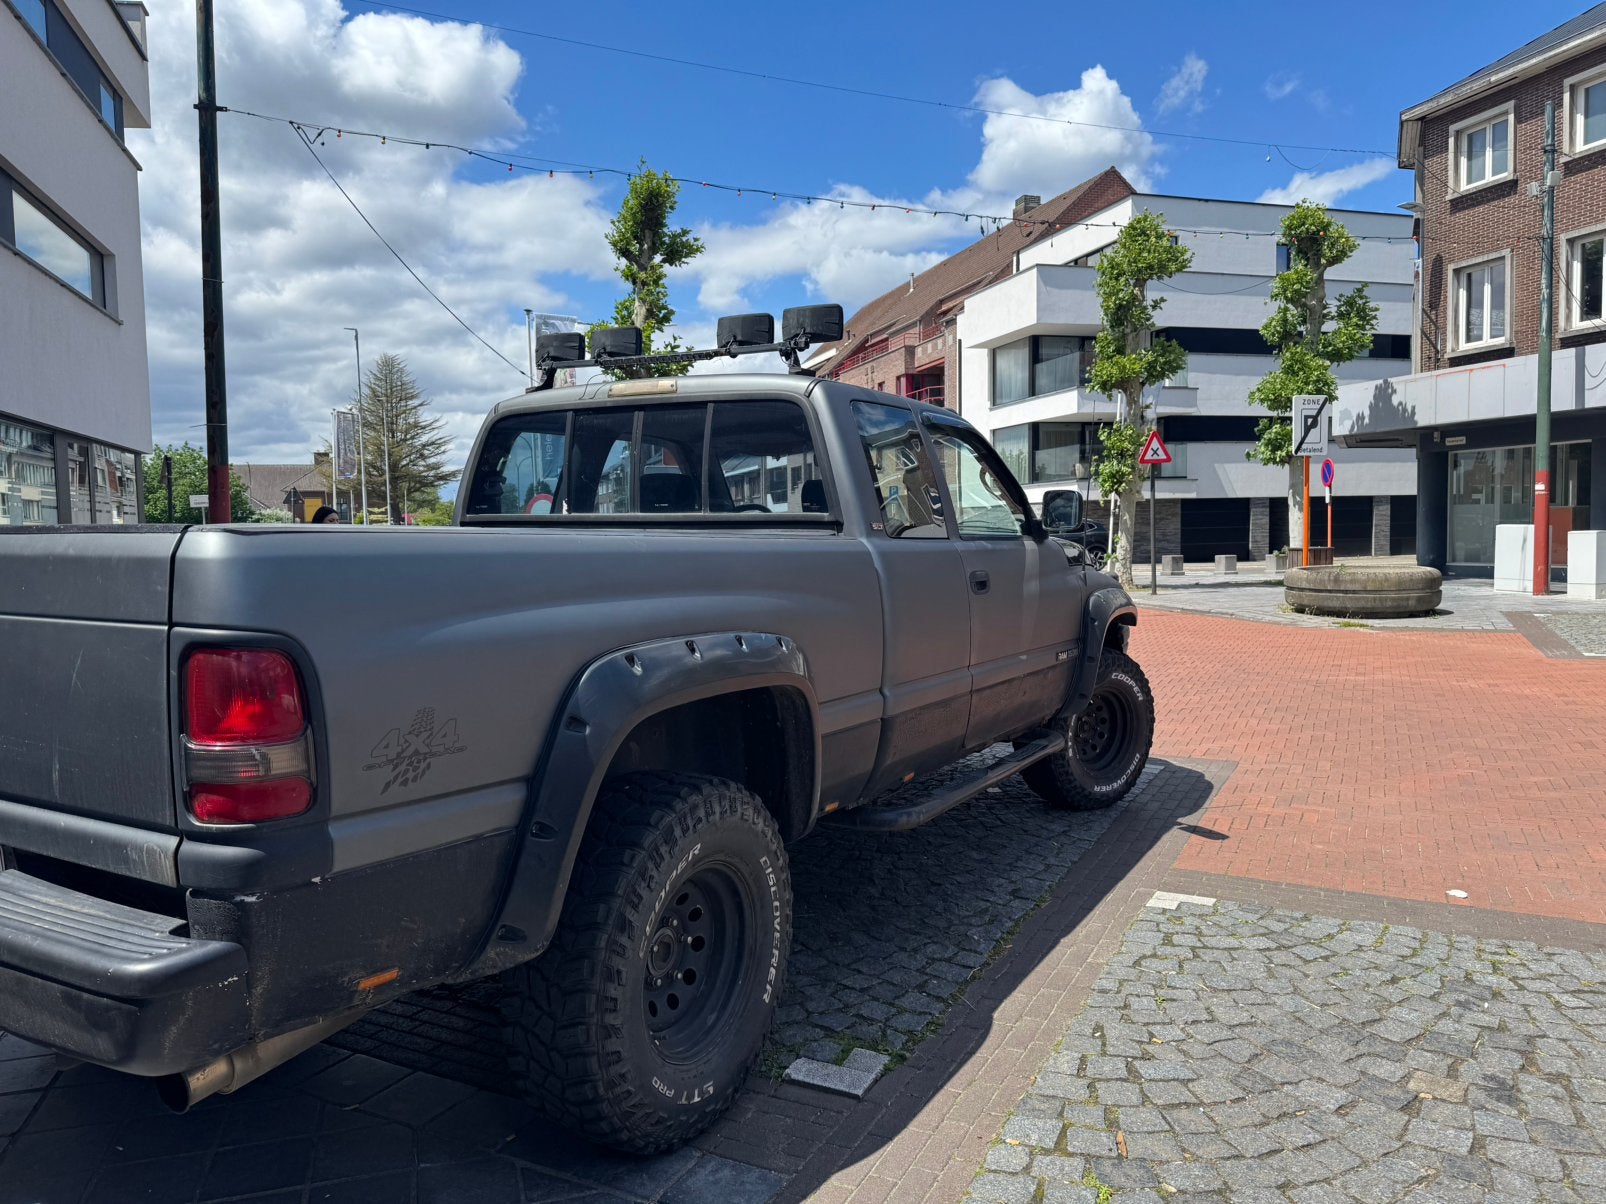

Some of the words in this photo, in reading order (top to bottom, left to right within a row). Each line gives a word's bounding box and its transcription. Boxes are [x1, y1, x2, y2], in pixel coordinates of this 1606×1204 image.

[1111, 672, 1144, 702] COOPER
[1093, 753, 1141, 793] DISCOVERER
[639, 842, 701, 960] COOPER
[759, 855, 783, 1004] DISCOVERER
[651, 1076, 675, 1098] PRO
